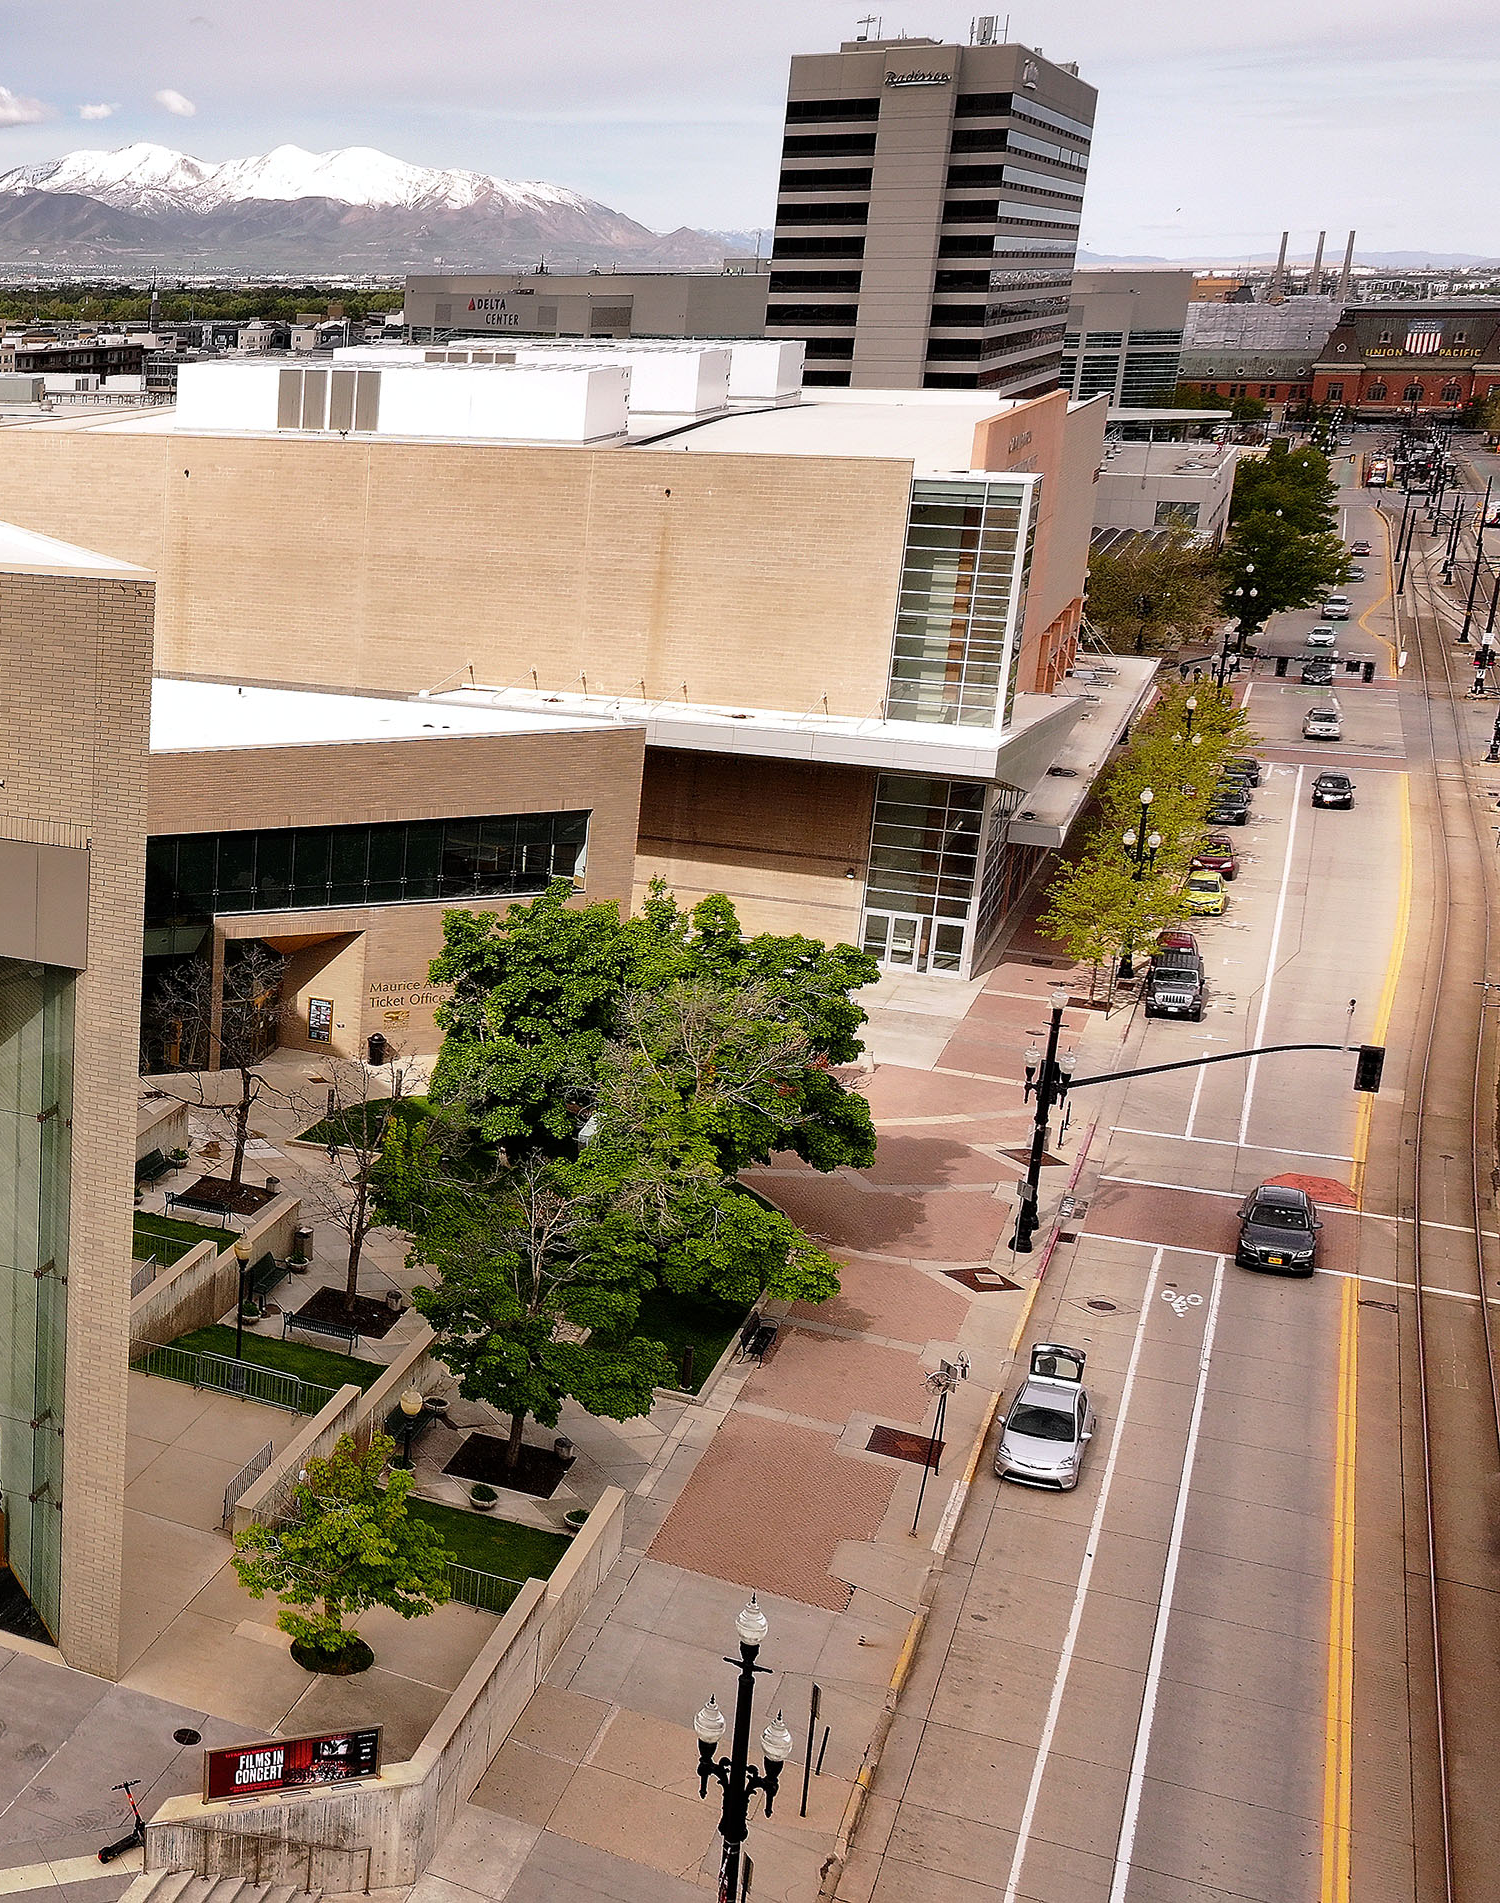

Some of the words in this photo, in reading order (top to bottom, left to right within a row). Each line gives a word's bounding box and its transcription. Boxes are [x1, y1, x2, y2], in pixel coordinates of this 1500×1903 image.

[884, 69, 952, 86] Radisson
[477, 298, 506, 311] DELTA
[485, 312, 519, 326] CENTER
[1365, 348, 1403, 357] UNION
[1439, 348, 1482, 357] PACIFIC
[369, 980, 421, 993] Maurice
[369, 996, 405, 1008] Ticket
[409, 992, 446, 1006] Office
[239, 1751, 271, 1770] FILMS
[272, 1749, 284, 1766] IN
[235, 1764, 284, 1785] CONCERT
